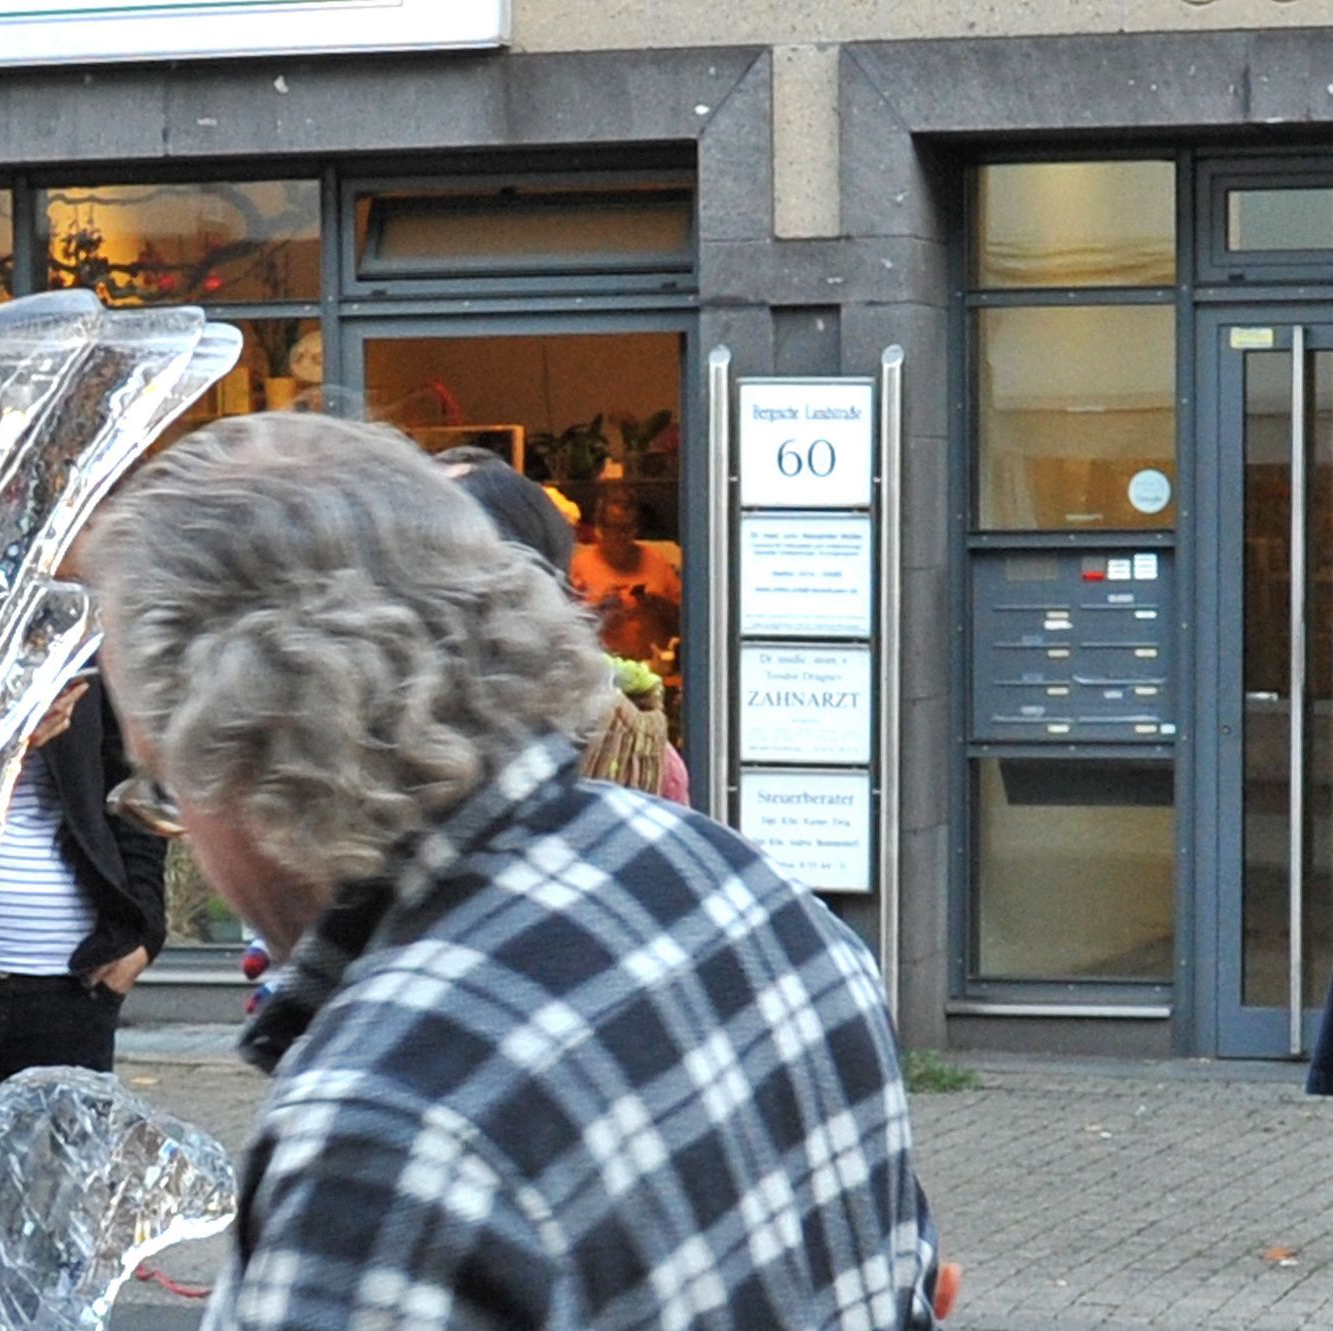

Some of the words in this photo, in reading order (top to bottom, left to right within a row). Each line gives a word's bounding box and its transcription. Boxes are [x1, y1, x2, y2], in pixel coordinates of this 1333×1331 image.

[777, 438, 837, 477] 60
[747, 690, 860, 709] ZAHNARZT
[757, 788, 855, 806] Steuerberater
